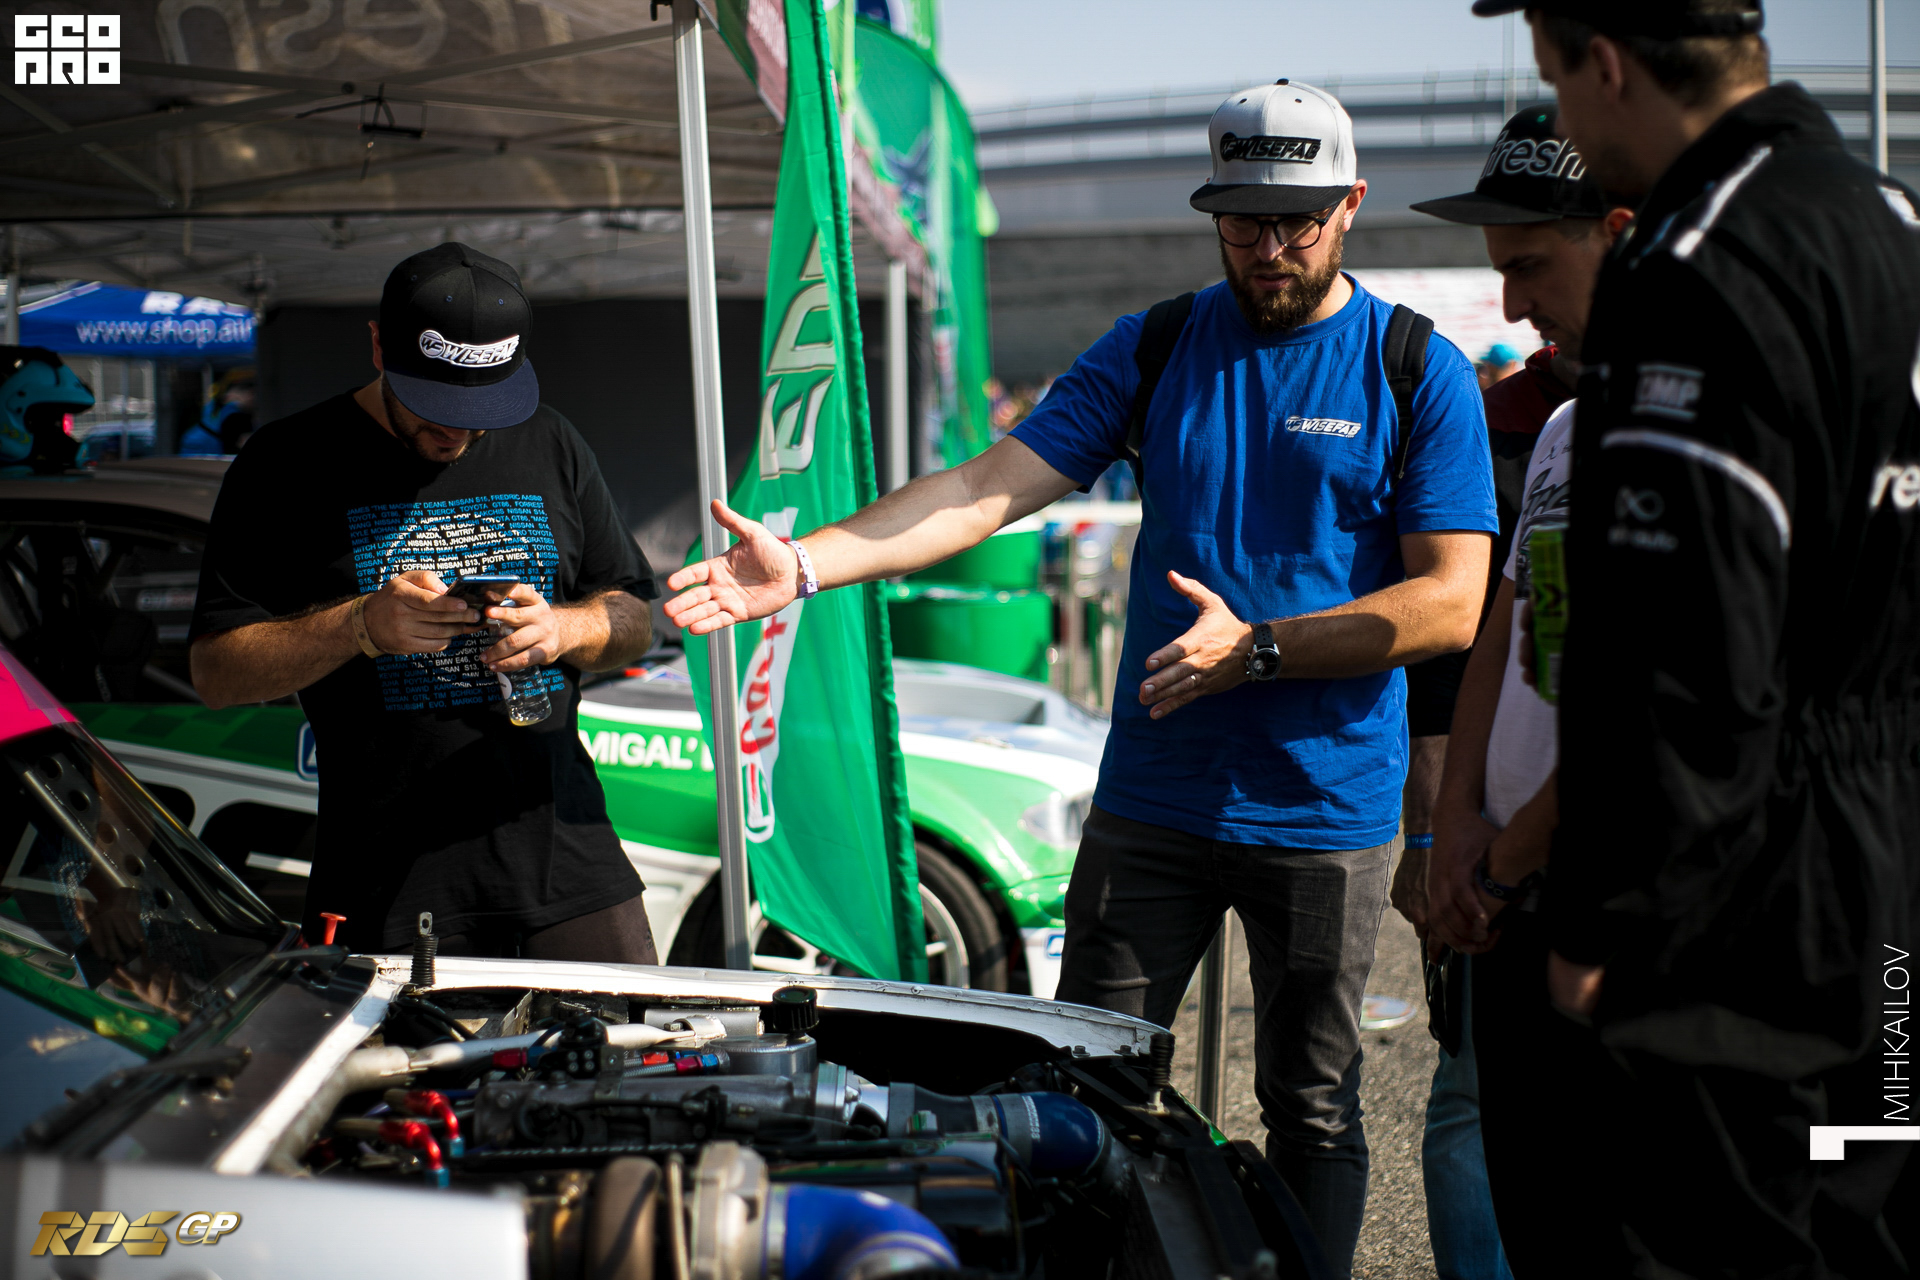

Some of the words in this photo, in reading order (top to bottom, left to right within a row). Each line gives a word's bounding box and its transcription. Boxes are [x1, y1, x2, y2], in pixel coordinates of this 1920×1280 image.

[1236, 139, 1322, 160] WISEFAB
[443, 339, 520, 364] WISEFAB
[1301, 420, 1361, 436] WISEFAB
[449, 498, 474, 507] NISSAN
[348, 514, 377, 522] TOYOTA
[427, 508, 456, 516] TUERCK
[460, 504, 488, 512] TOYOTA
[420, 516, 451, 524] AURIMAS
[474, 509, 504, 518] BAKCHIS
[351, 530, 369, 538] KYLE
[371, 526, 397, 534] MOHAN
[457, 519, 479, 528] GUSHI
[481, 516, 510, 524] TOYOTA
[374, 533, 411, 541] WHIDDETT
[446, 528, 475, 537] DMITRIY
[353, 543, 376, 553] MITCH
[472, 539, 501, 549] ARKADY
[356, 559, 383, 568] NISSAN
[387, 556, 417, 564] SKYLINE
[532, 544, 558, 552] TOYOTA
[380, 565, 399, 573] MATT
[437, 561, 463, 570] NISSAN
[482, 555, 504, 565] PIOTR
[502, 561, 525, 569] STEVE
[435, 658, 453, 666] BMW
[451, 696, 483, 706] MARKOS
